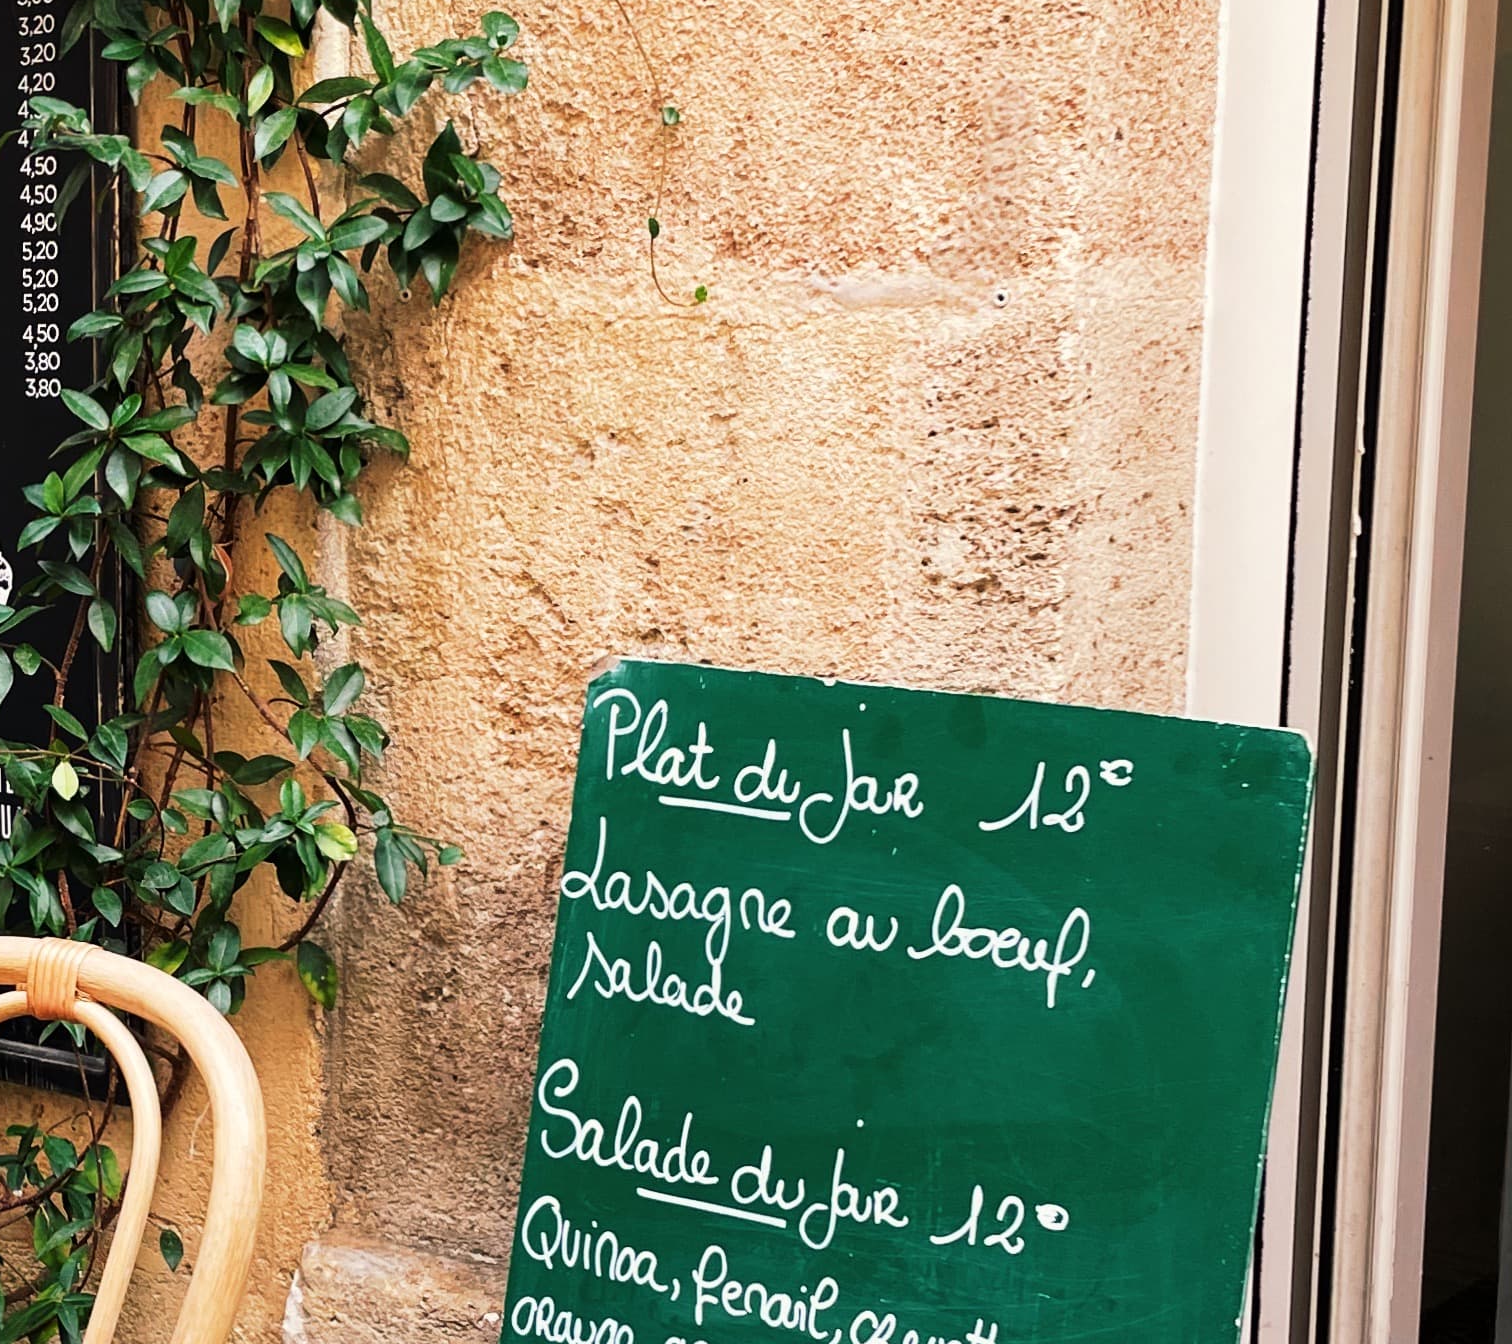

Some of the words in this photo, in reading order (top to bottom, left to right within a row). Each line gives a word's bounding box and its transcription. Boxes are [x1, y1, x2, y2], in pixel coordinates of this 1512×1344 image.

[17, 13, 55, 37] 3,20
[19, 41, 56, 66] 3,20
[16, 71, 56, 94] 4,20
[18, 154, 57, 179] 4,50
[18, 183, 58, 206] 4,50
[19, 211, 57, 235] 4,90
[21, 239, 58, 263] 5,20
[21, 267, 59, 290] 5,20
[21, 292, 59, 314] 5,20
[23, 350, 61, 374] 3,80
[24, 377, 61, 399] 3,80
[594, 689, 717, 789] Plat
[733, 739, 800, 804] du
[560, 817, 796, 961] Lasagne
[827, 905, 897, 952] au
[567, 933, 755, 1025] salade
[538, 1058, 719, 1186] Salade
[730, 1145, 806, 1211] du
[521, 1195, 680, 1302] Quinoa,
